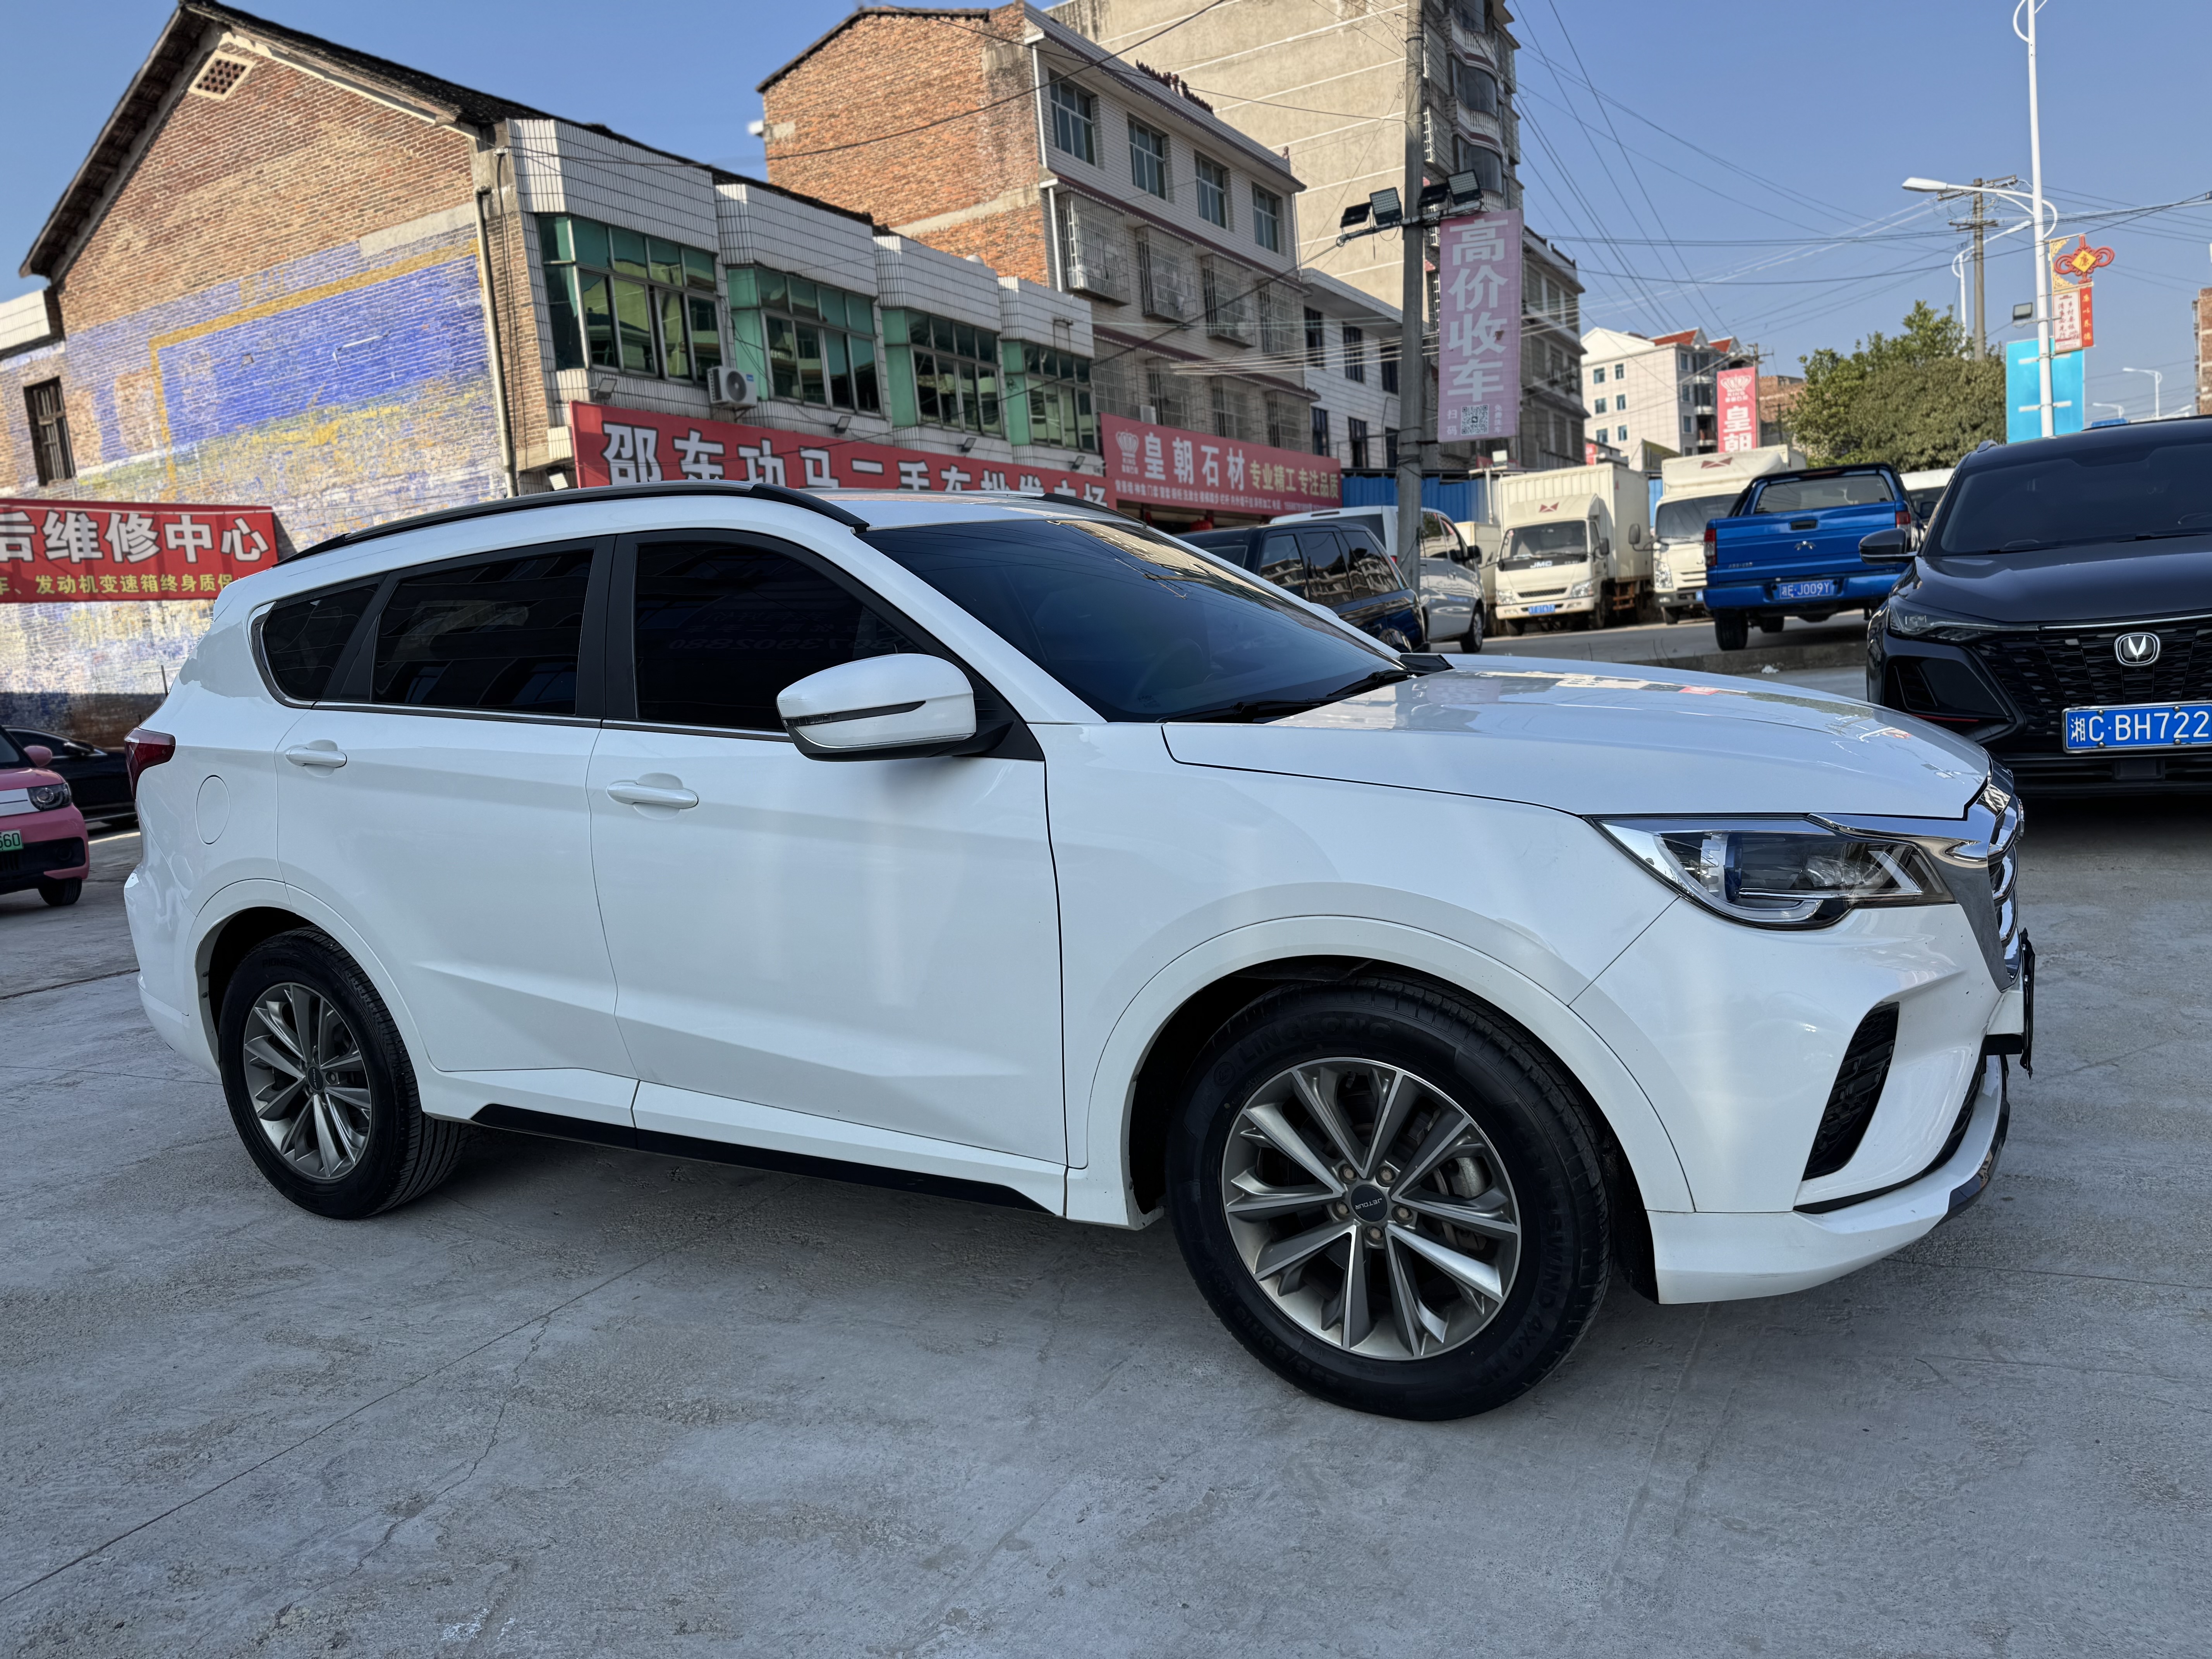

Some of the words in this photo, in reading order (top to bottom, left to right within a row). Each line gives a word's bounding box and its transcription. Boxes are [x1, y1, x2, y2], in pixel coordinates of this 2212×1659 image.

[1447, 218, 1509, 402] 高价收车
[1447, 409, 1457, 436] 扫码
[1723, 405, 1752, 452] 皇朝
[1144, 431, 1245, 491] 皇朝石材
[1250, 460, 1297, 493] 专业精工
[1298, 467, 1339, 499] 专注品质
[1238, 1017, 1391, 1064] LINGLONG
[1355, 1198, 1382, 1210] JETOUR
